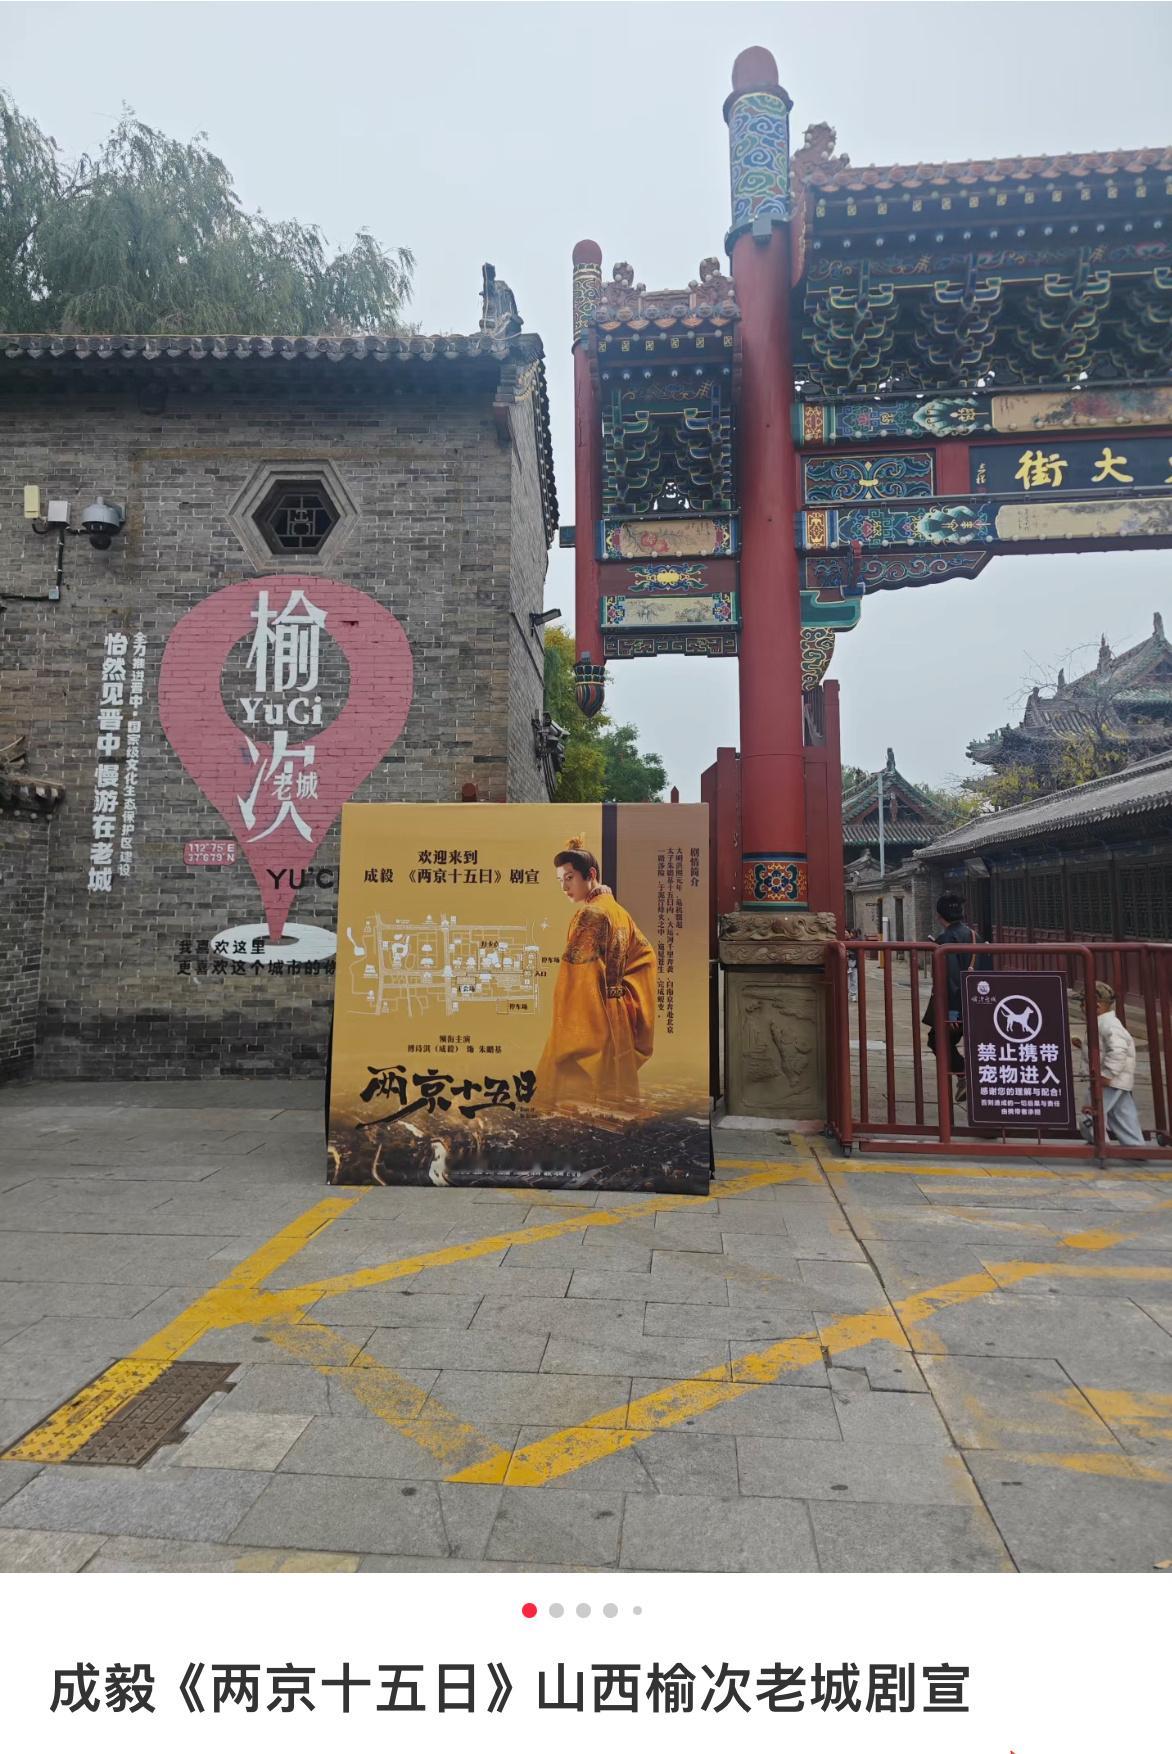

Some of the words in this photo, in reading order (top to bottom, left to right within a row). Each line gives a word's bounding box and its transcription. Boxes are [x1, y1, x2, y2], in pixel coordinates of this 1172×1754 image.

[246, 590, 328, 692] 榆
[237, 730, 315, 843] 次
[271, 770, 319, 800] 老城
[418, 850, 478, 865] 欢迎来到
[178, 940, 265, 955] 我喜欢这里
[977, 1043, 1059, 1062] 禁止携带
[978, 1065, 1060, 1085] 宠物进入
[355, 1065, 537, 1130] 两京十五日
